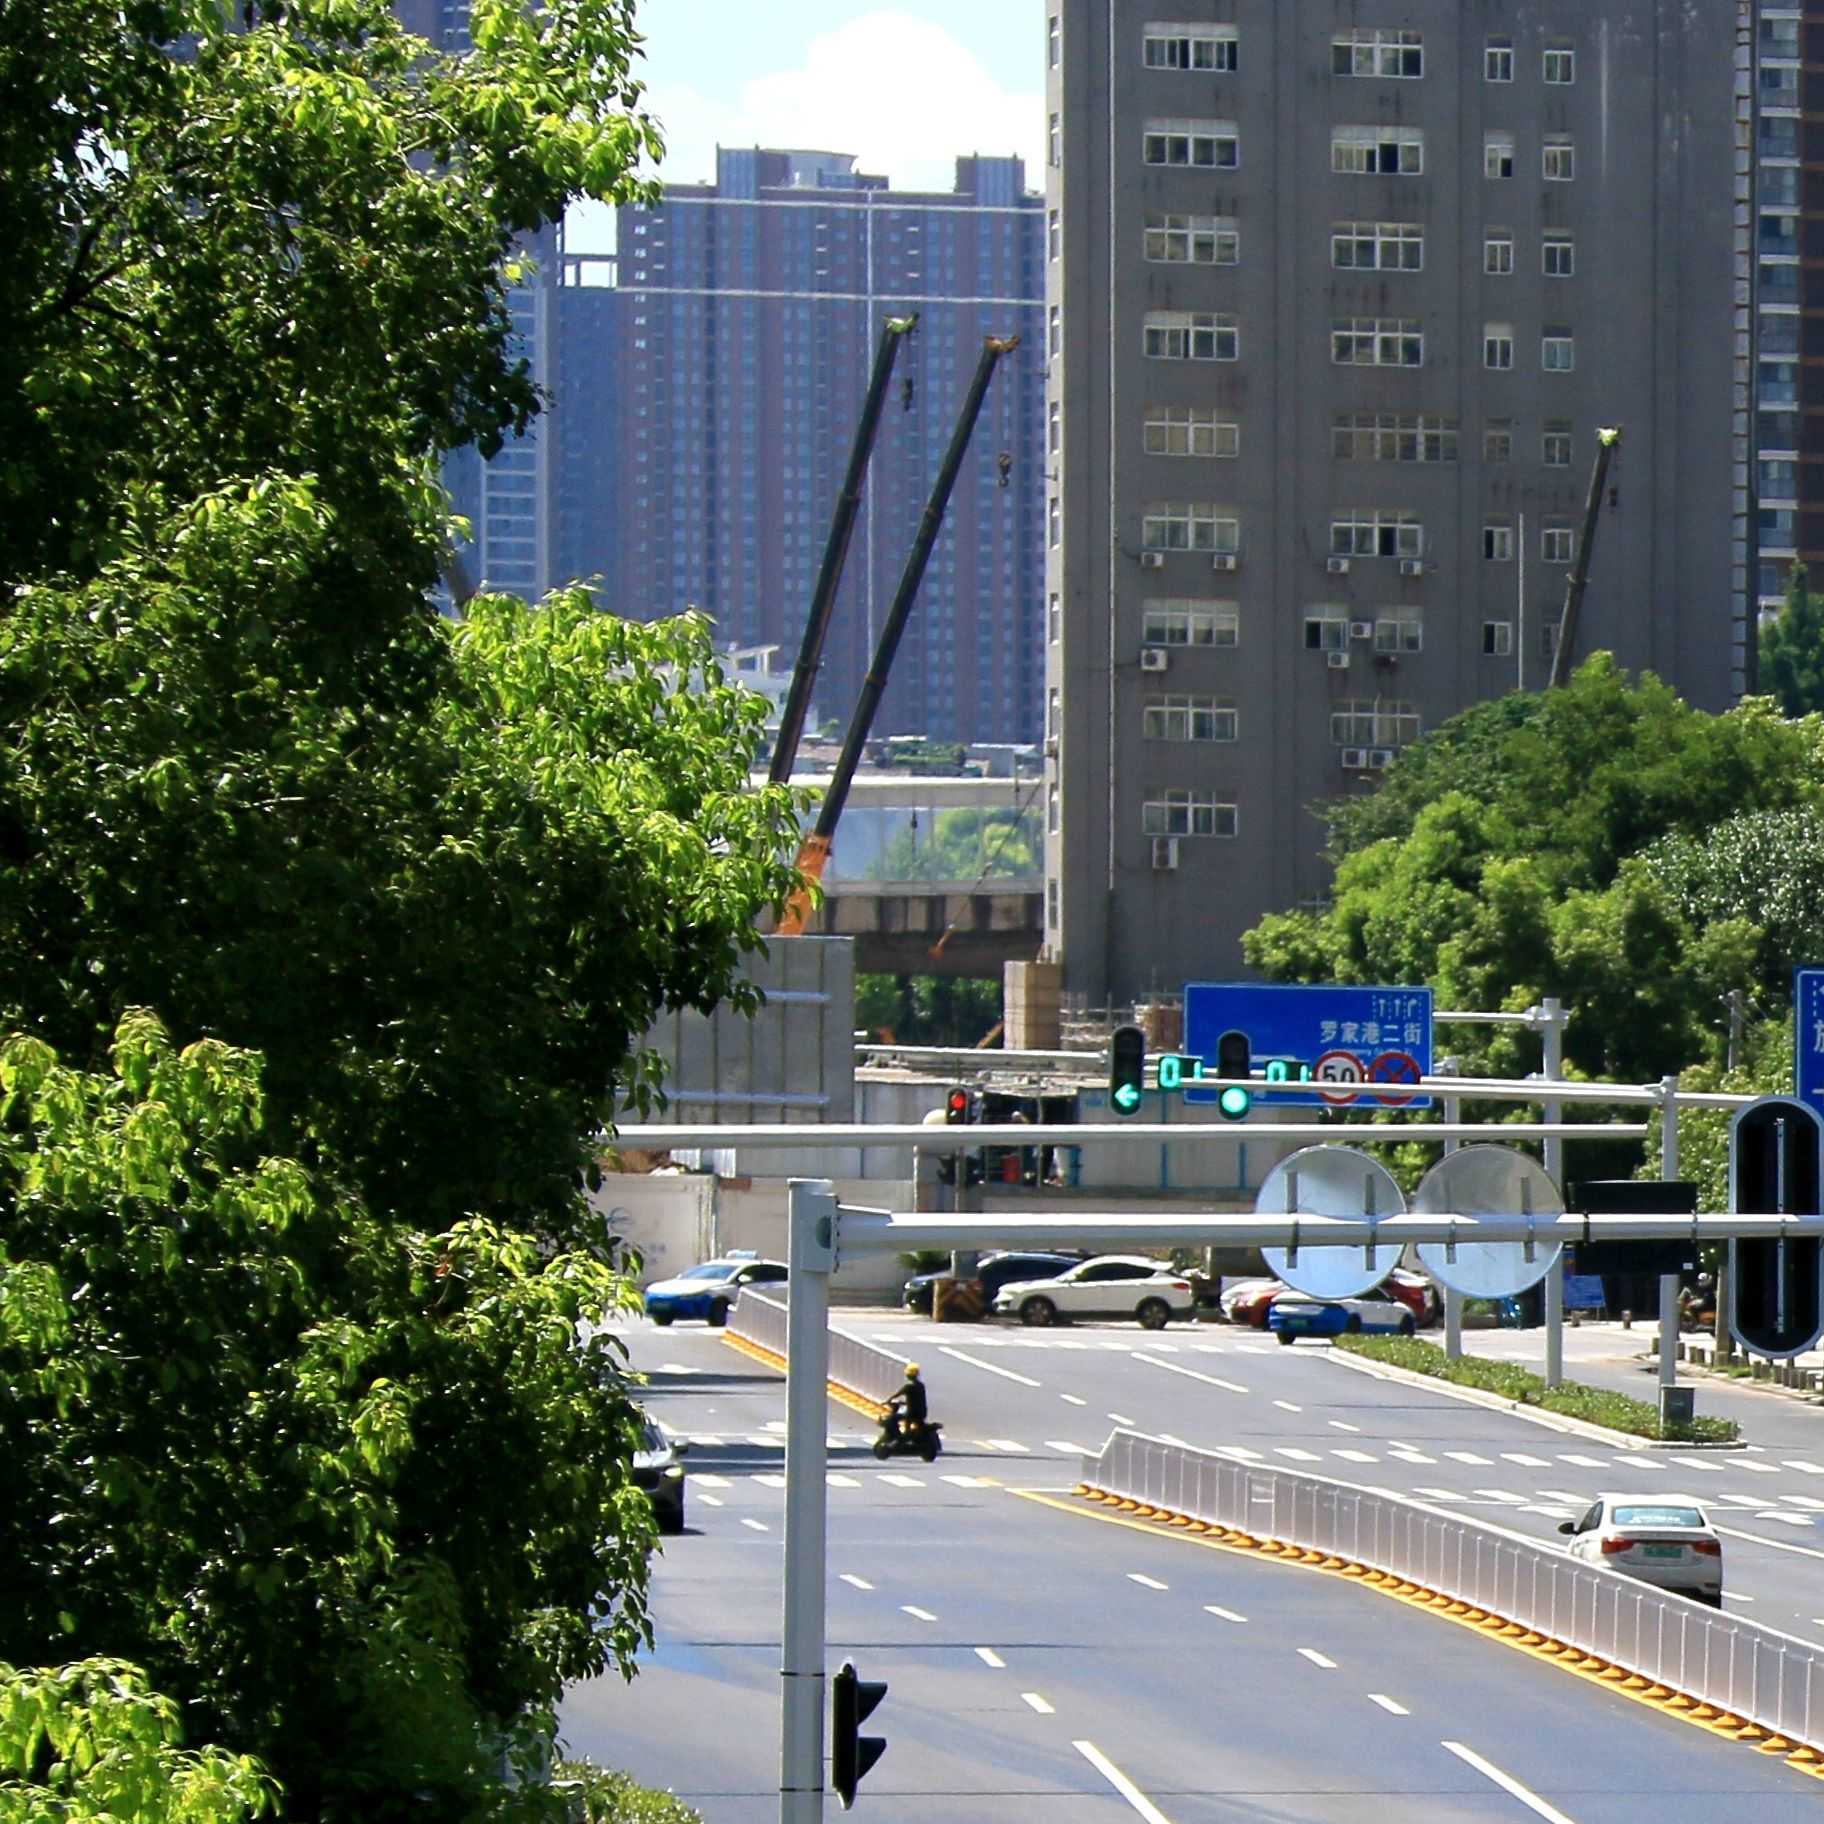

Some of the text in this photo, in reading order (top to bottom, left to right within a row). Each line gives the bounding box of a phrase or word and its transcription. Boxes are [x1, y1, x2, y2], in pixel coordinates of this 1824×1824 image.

[1320, 1020, 1421, 1045] 罗家港二街
[1323, 1065, 1354, 1084] 50
